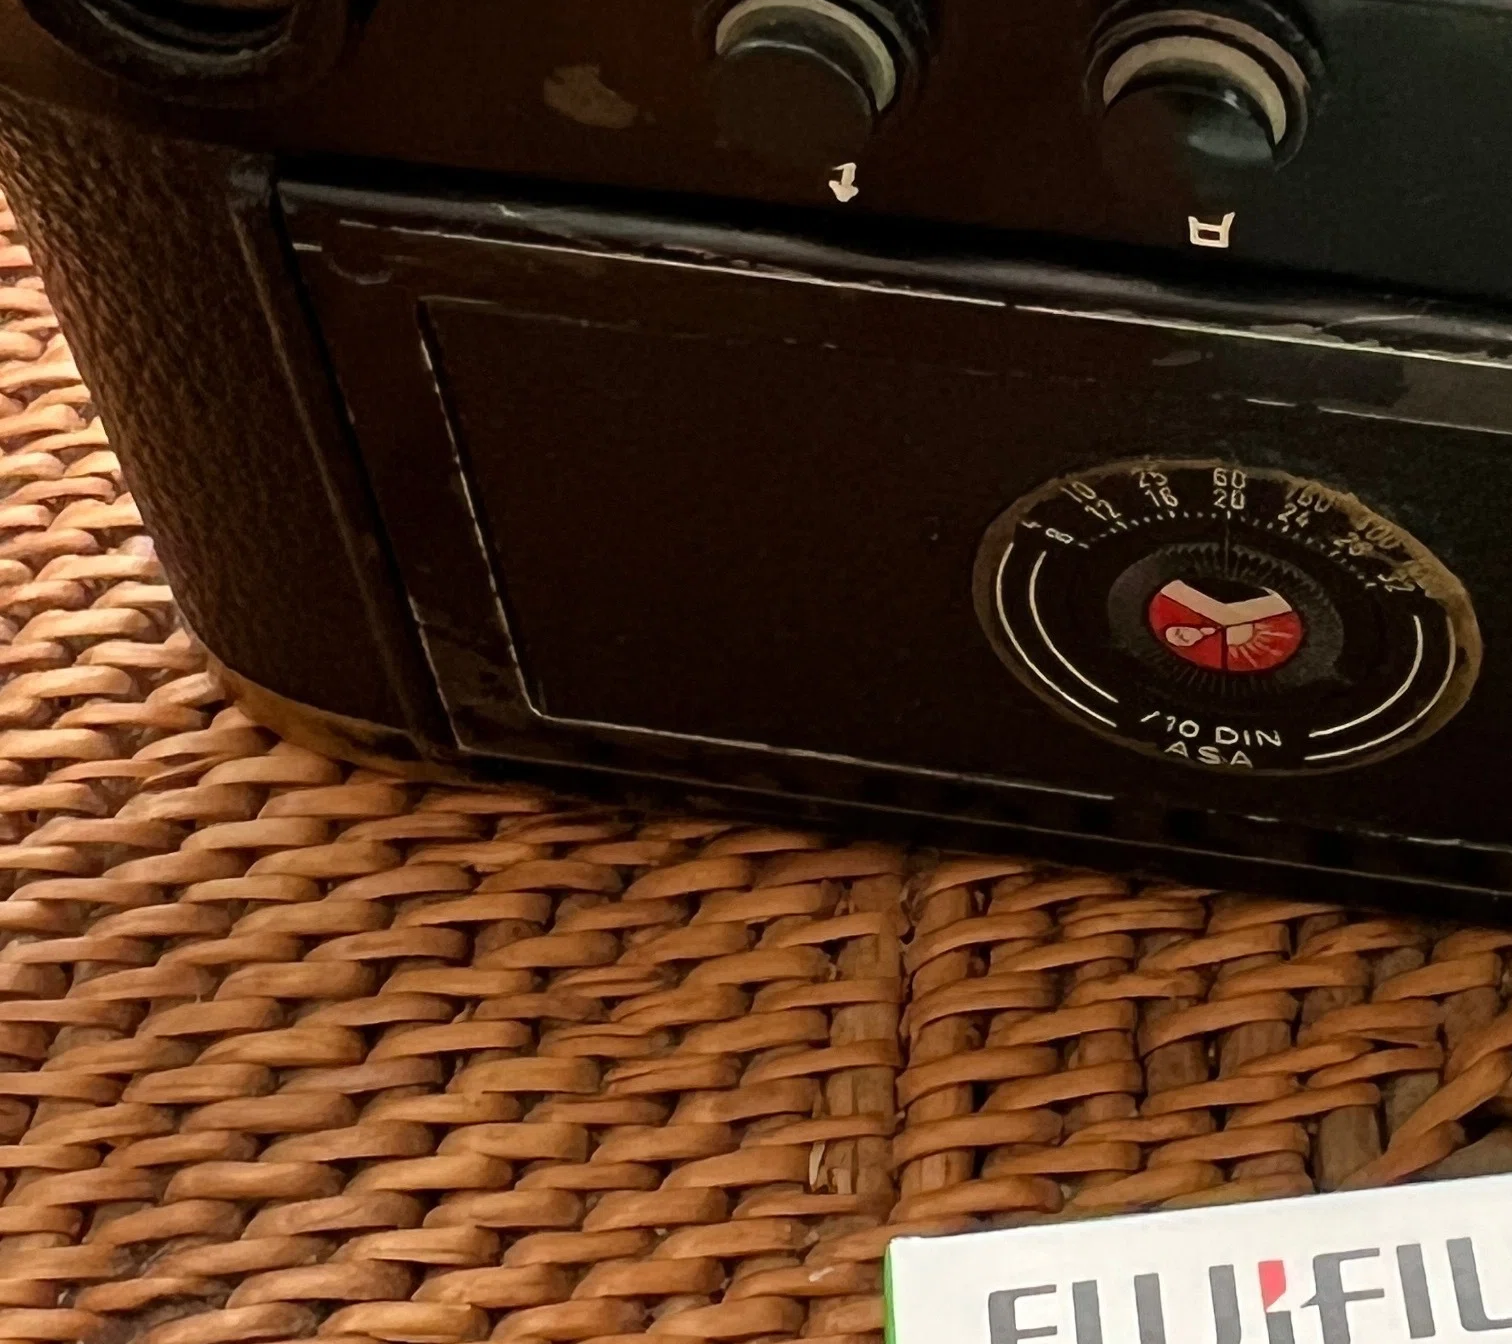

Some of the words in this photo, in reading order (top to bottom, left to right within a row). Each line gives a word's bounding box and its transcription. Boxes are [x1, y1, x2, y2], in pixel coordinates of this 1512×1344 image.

[1213, 467, 1247, 489] 60
[1213, 488, 1245, 509] 20
[1215, 725, 1282, 747] DIN
[1163, 740, 1254, 769] ASA
